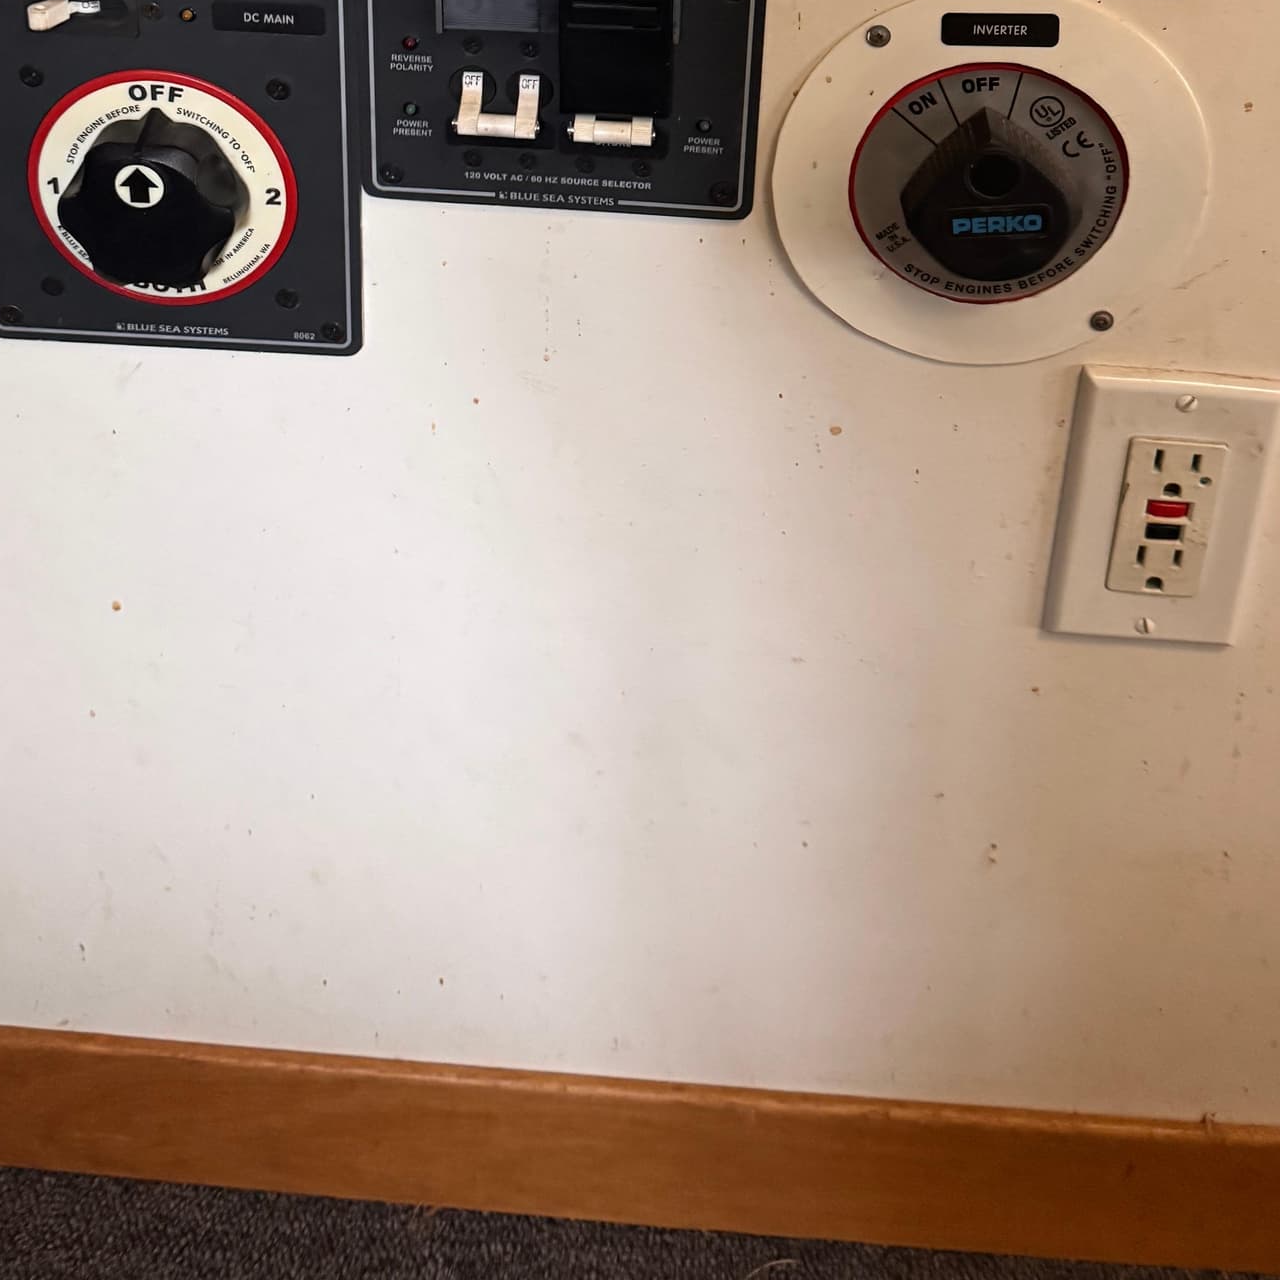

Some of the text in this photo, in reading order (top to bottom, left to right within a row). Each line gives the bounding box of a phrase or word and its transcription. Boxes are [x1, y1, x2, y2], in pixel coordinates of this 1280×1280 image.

[243, 12, 295, 25] DC MAIN
[972, 23, 1028, 37] INVERTER
[391, 53, 433, 64] REVERSE
[389, 62, 434, 73] POLARITY
[464, 73, 481, 88] OFF
[521, 78, 538, 91] OFF
[961, 76, 1001, 94] OFF
[127, 83, 184, 103] OFF
[908, 90, 938, 117] ON
[1035, 104, 1062, 119] UL
[175, 107, 230, 140] SWITCHING
[228, 136, 241, 151] TO
[396, 119, 429, 129] POWER
[1045, 116, 1077, 141] LISTED
[66, 104, 142, 165] STOP ENGINE BEFORE
[393, 127, 433, 138] PRESENT
[687, 136, 721, 147] POWER
[683, 144, 724, 156] PRESENT
[47, 177, 60, 195] 1
[464, 170, 482, 180] 120
[483, 171, 509, 182] VOLT
[510, 173, 524, 183] AC
[545, 175, 558, 185] HZ
[559, 176, 600, 187] SOURCE
[601, 178, 652, 190] SELECTOR
[265, 188, 282, 206] 2
[509, 191, 615, 207] BLUE SEA SYSTEMS
[951, 214, 1043, 235] PERKO
[225, 227, 256, 261] IN AMERICA
[904, 263, 941, 286] STOP
[944, 281, 1013, 296] ENGINES
[1018, 256, 1075, 290] BEFORE
[1074, 184, 1118, 257] SWITCHING
[260, 243, 272, 255] WA
[127, 322, 229, 337] BLUE SEA SYSTEMS
